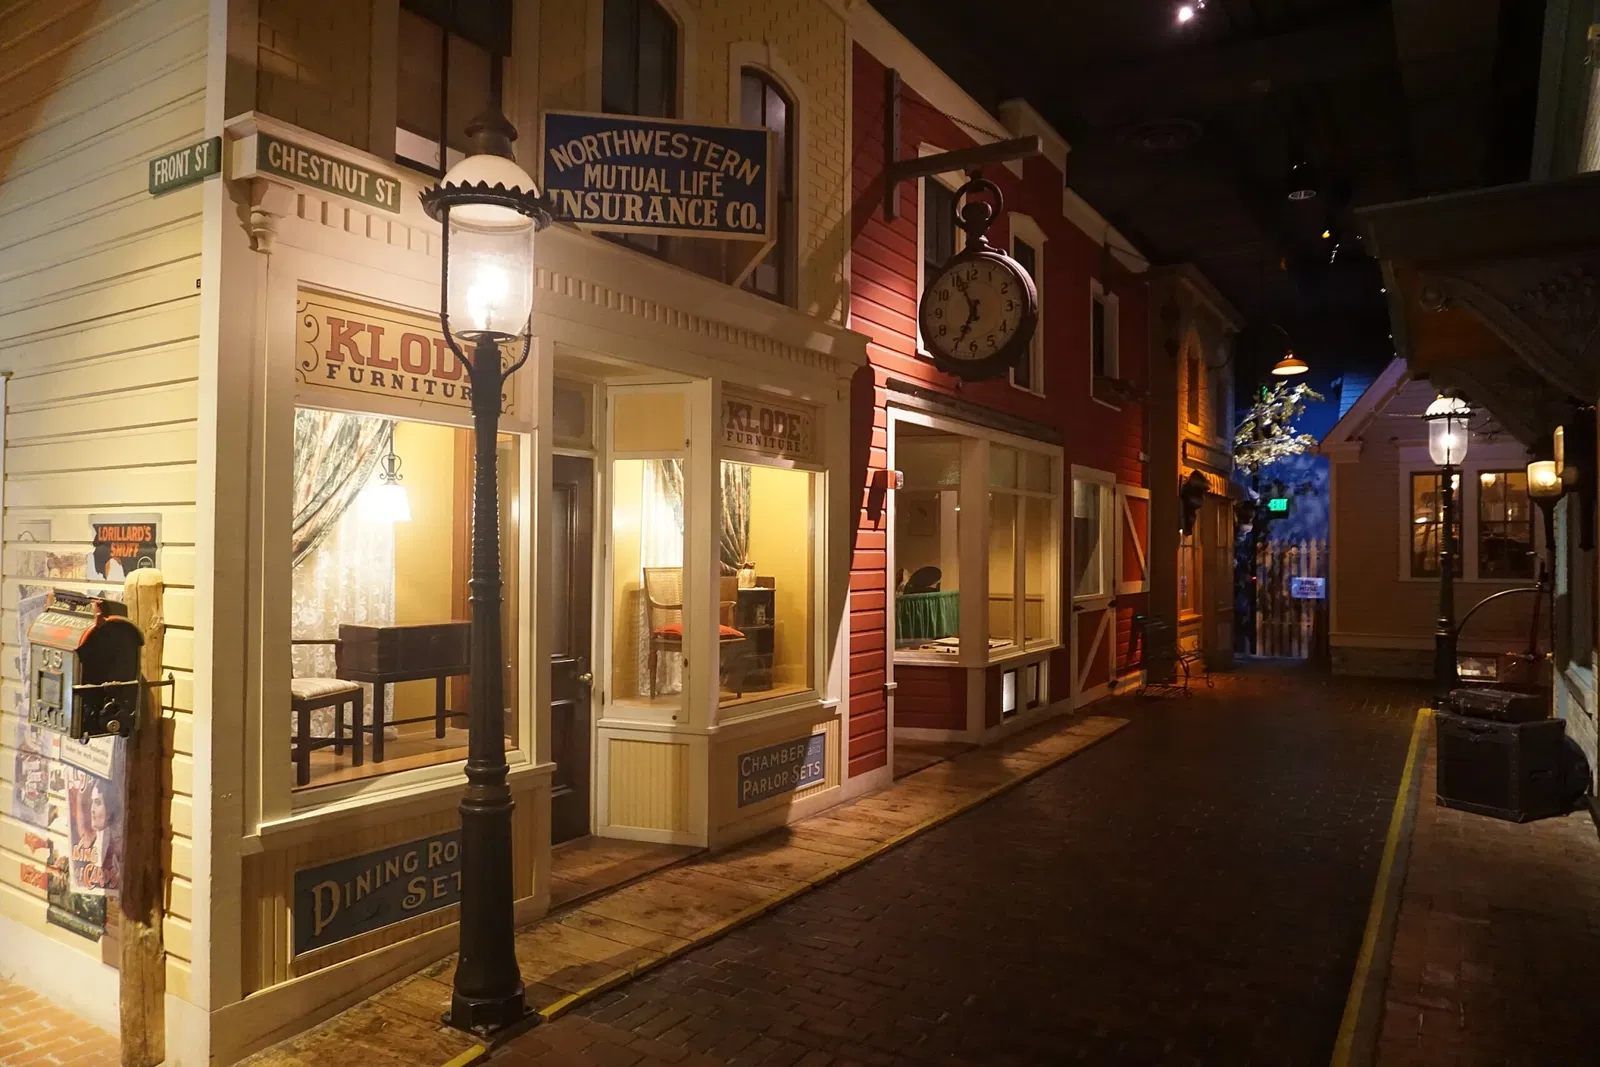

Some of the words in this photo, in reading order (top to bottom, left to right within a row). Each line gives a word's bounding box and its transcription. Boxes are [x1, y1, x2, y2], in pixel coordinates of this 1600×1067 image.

[154, 150, 190, 186] FRONT
[194, 142, 210, 172] ST
[550, 129, 761, 185] NORTHWESTERN
[267, 141, 369, 197] CHESTNUT
[375, 177, 396, 206] ST
[583, 163, 671, 194] MUTUAL
[680, 169, 725, 197] LIFE
[726, 201, 763, 230] CO.
[966, 269, 978, 281] 12
[987, 271, 992, 282] 1
[939, 289, 949, 300] 10
[1001, 282, 1009, 295] 2
[935, 307, 943, 318] 9
[1005, 300, 1014, 312] 3
[939, 325, 947, 336] 8
[999, 319, 1007, 334] 4
[952, 337, 961, 351] 7
[969, 340, 978, 352] 6
[986, 334, 996, 348] 5
[326, 363, 473, 400] FURNITUR
[726, 400, 801, 441] KLODE
[727, 430, 801, 452] FURNITURE
[98, 525, 152, 542] LORILLARD'S
[110, 542, 139, 557] SNUFF
[31, 703, 69, 732] MAIL
[741, 744, 805, 777] CHAMBER
[743, 771, 789, 801] PARLOR
[791, 760, 821, 783] SETS
[312, 851, 419, 936] DINING
